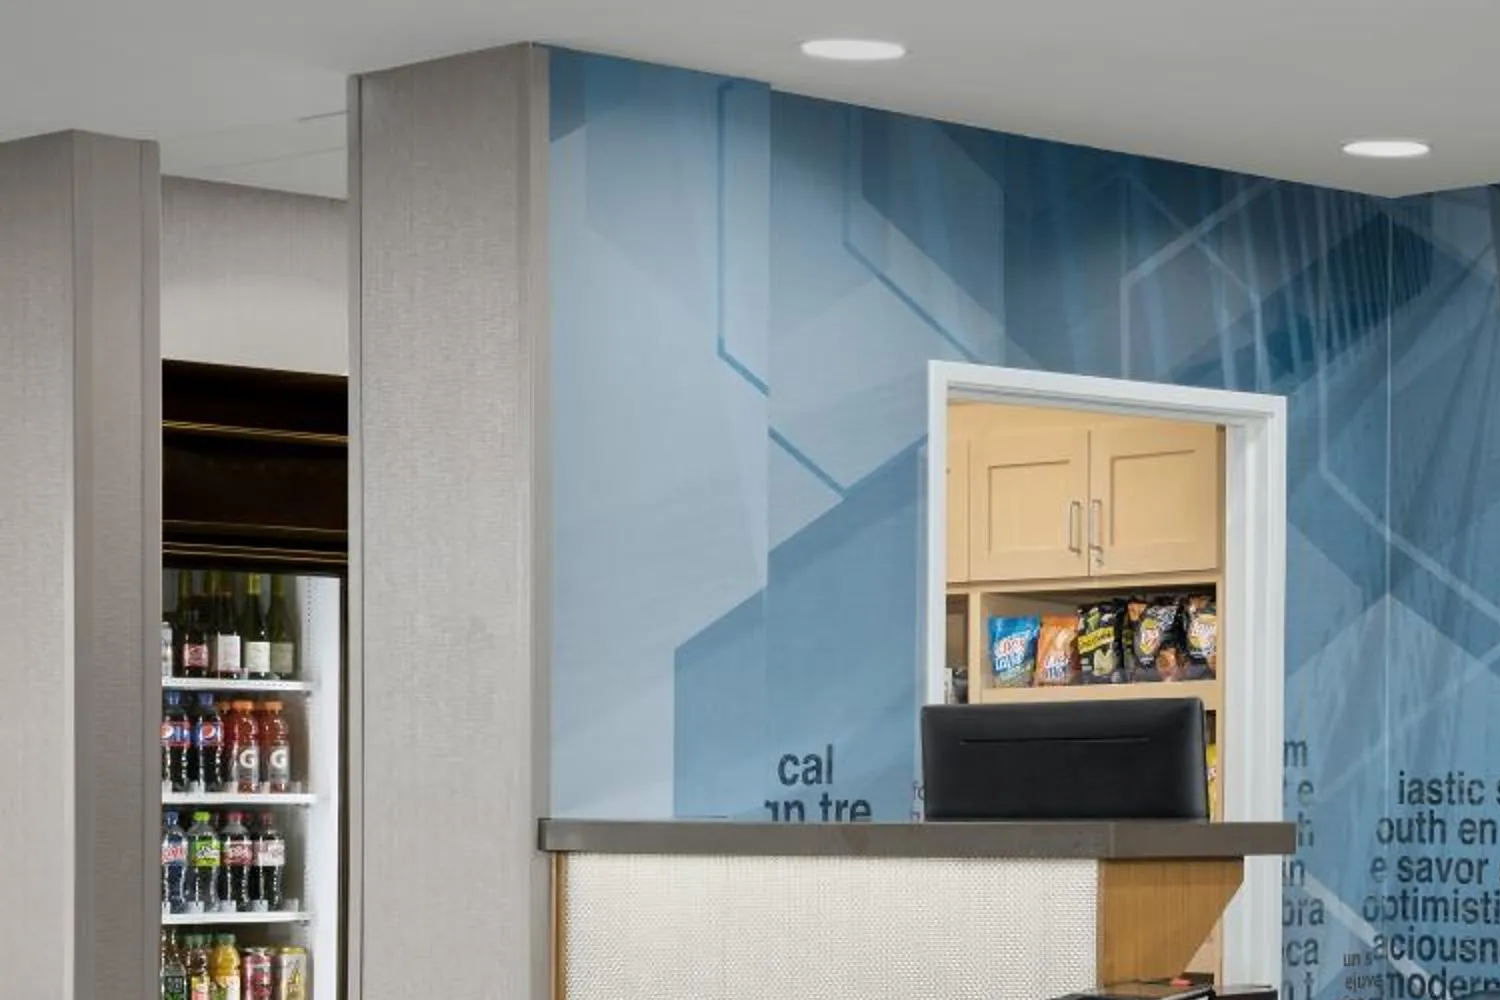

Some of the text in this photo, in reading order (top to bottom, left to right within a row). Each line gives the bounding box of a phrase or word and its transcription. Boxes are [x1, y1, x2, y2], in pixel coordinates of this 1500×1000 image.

[778, 743, 834, 786] cal
[1398, 770, 1486, 806] iastic
[1458, 818, 1498, 847] en
[1397, 856, 1489, 885] savor
